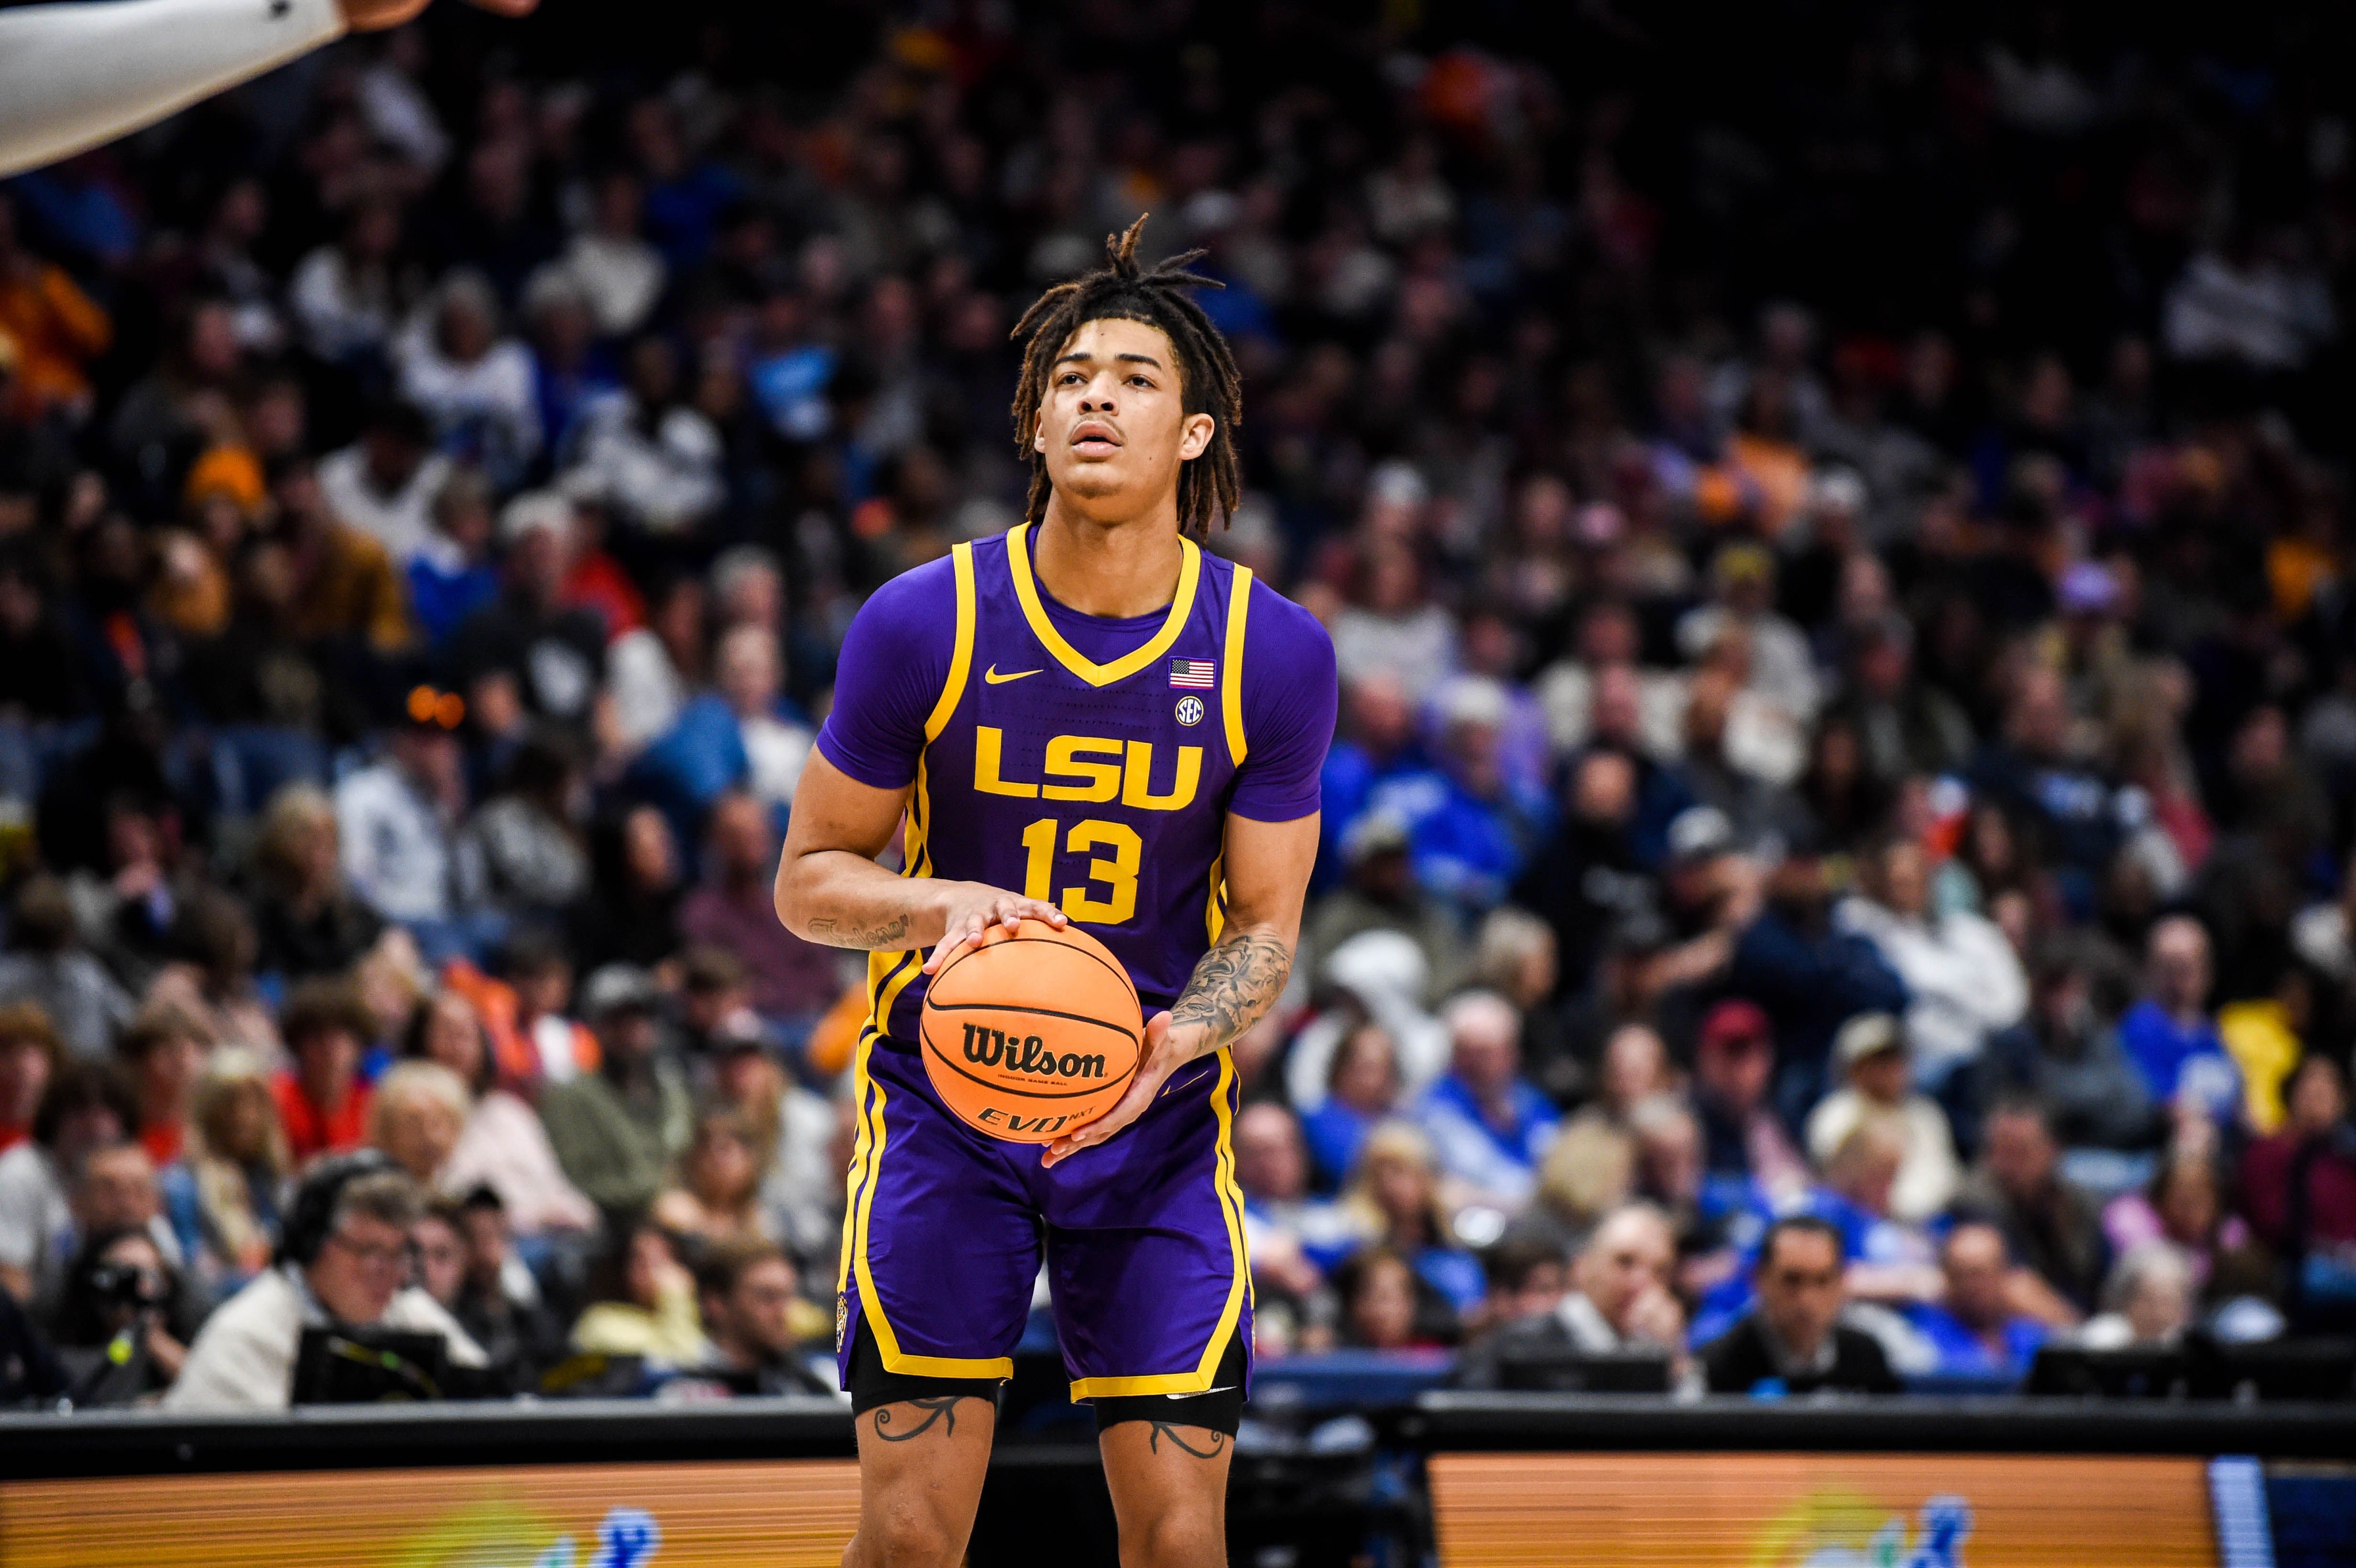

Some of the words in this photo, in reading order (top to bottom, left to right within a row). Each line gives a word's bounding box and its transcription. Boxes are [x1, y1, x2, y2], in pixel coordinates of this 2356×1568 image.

[1178, 699, 1201, 723] SEC
[974, 725, 1203, 811] LSU
[1022, 818, 1143, 925] 13
[962, 1022, 1105, 1078] Wilson
[997, 1074, 1025, 1082] INDOOR
[977, 1107, 1068, 1132] EVO
[1068, 1105, 1096, 1121] NXT
